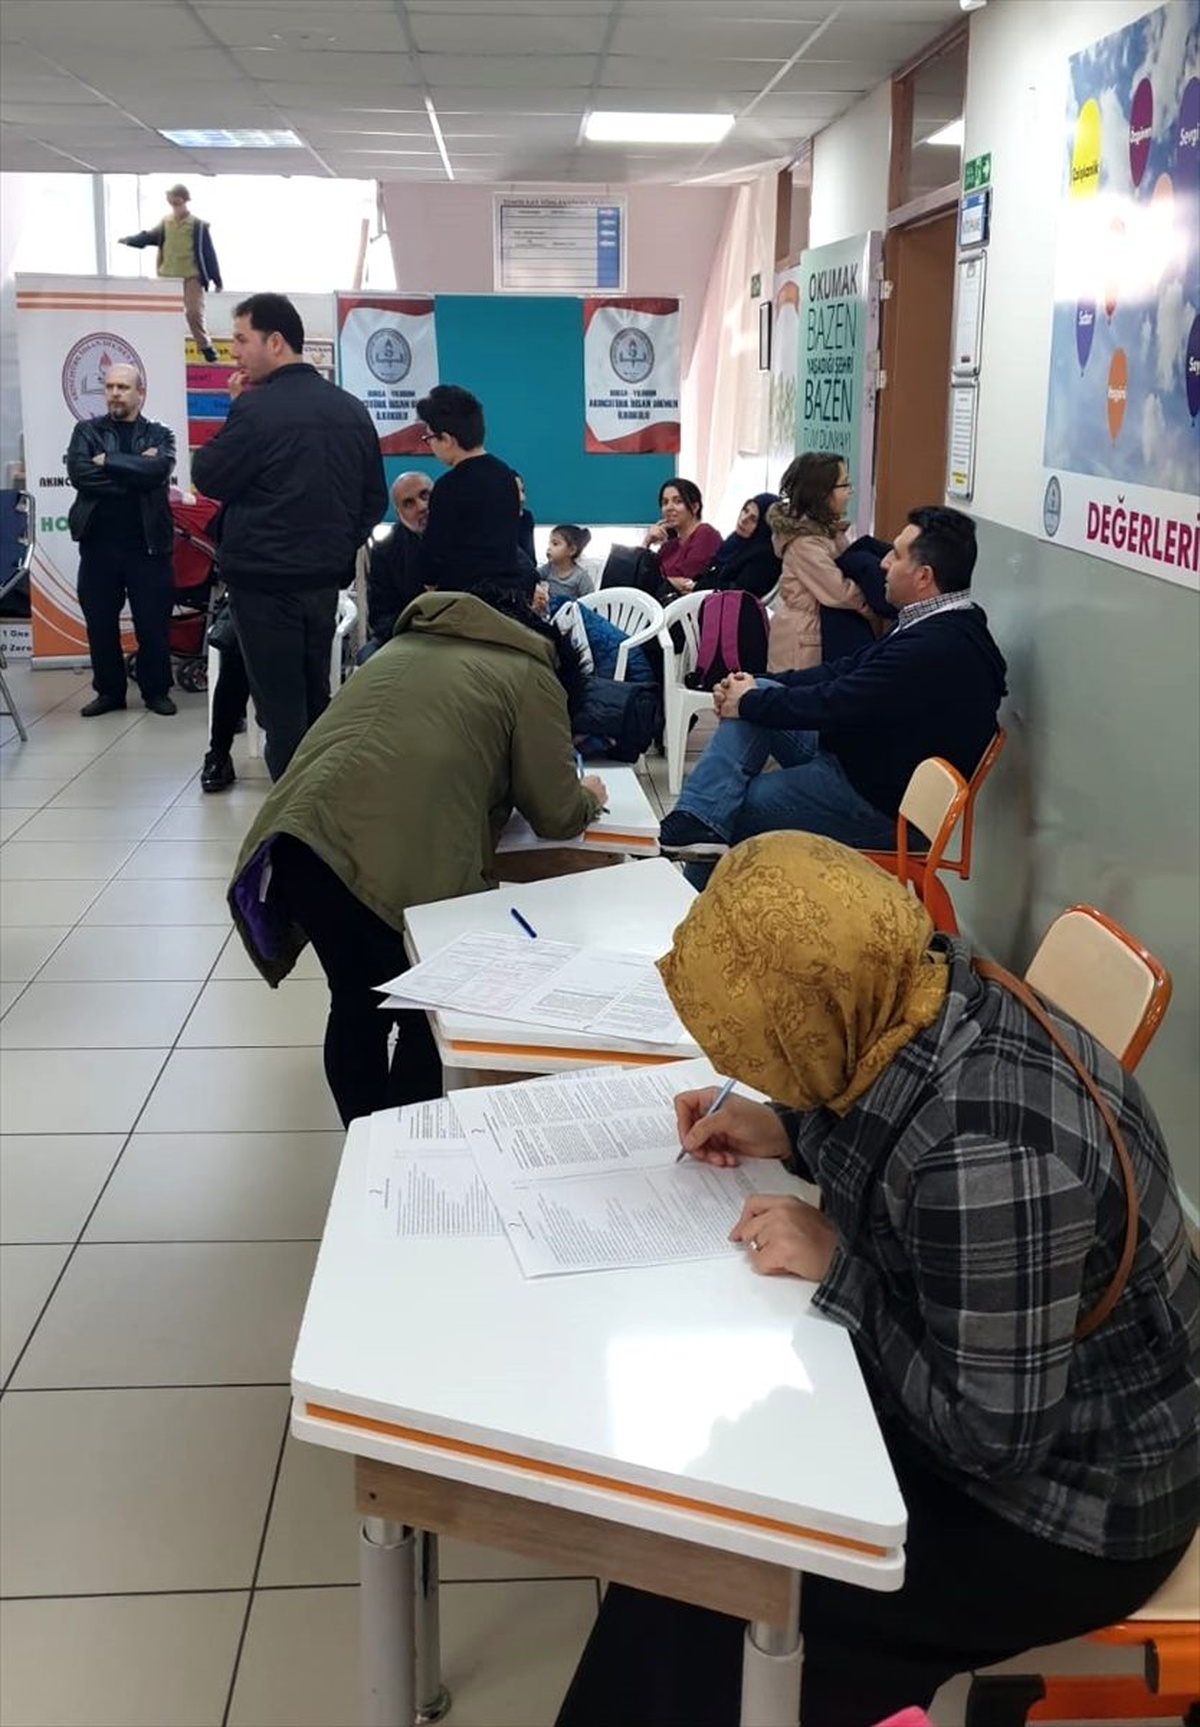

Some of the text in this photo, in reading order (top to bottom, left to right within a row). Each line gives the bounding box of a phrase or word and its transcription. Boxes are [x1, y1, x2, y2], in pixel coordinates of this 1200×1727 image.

[809, 263, 858, 302] OKUMAK
[807, 301, 857, 351] BAZEN
[804, 379, 853, 423] BAZEN
[39, 477, 73, 487] AKINC
[41, 517, 70, 532] HO
